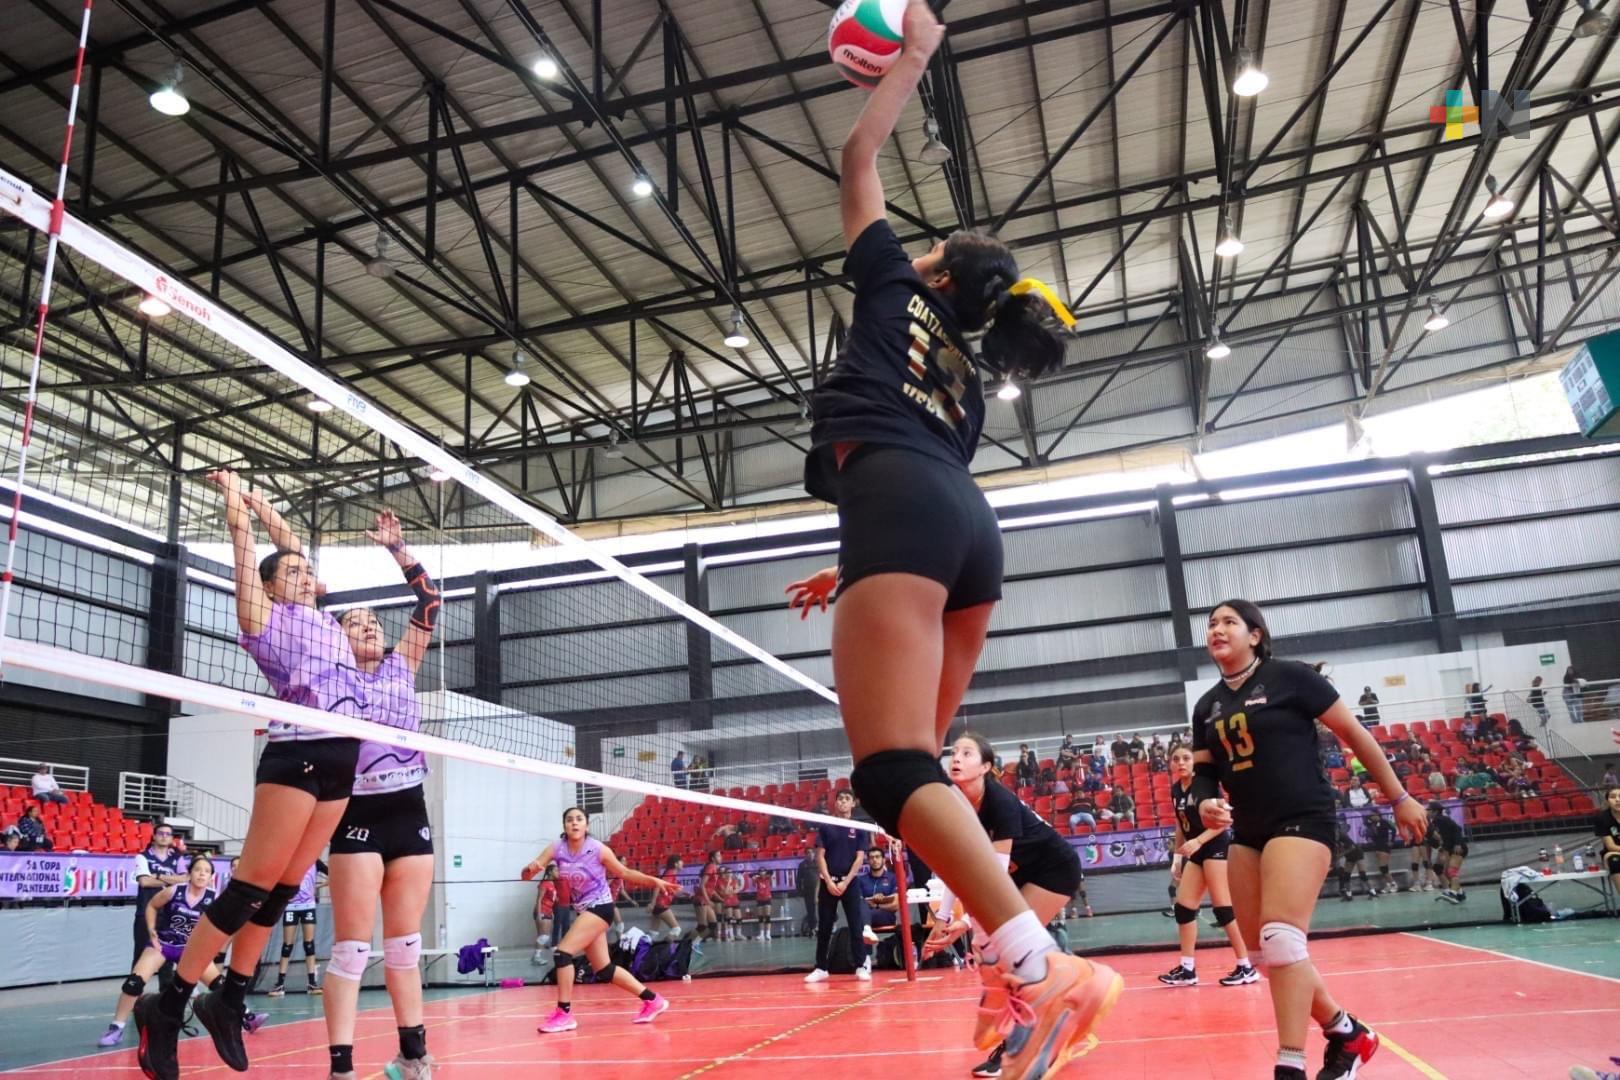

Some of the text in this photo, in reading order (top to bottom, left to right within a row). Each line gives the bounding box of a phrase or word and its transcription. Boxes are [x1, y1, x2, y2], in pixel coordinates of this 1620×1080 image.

[843, 48, 882, 74] molten
[1215, 712, 1255, 761] 13
[345, 825, 370, 842] 20
[40, 860, 61, 871] COPA
[17, 882, 60, 893] PANTERAS
